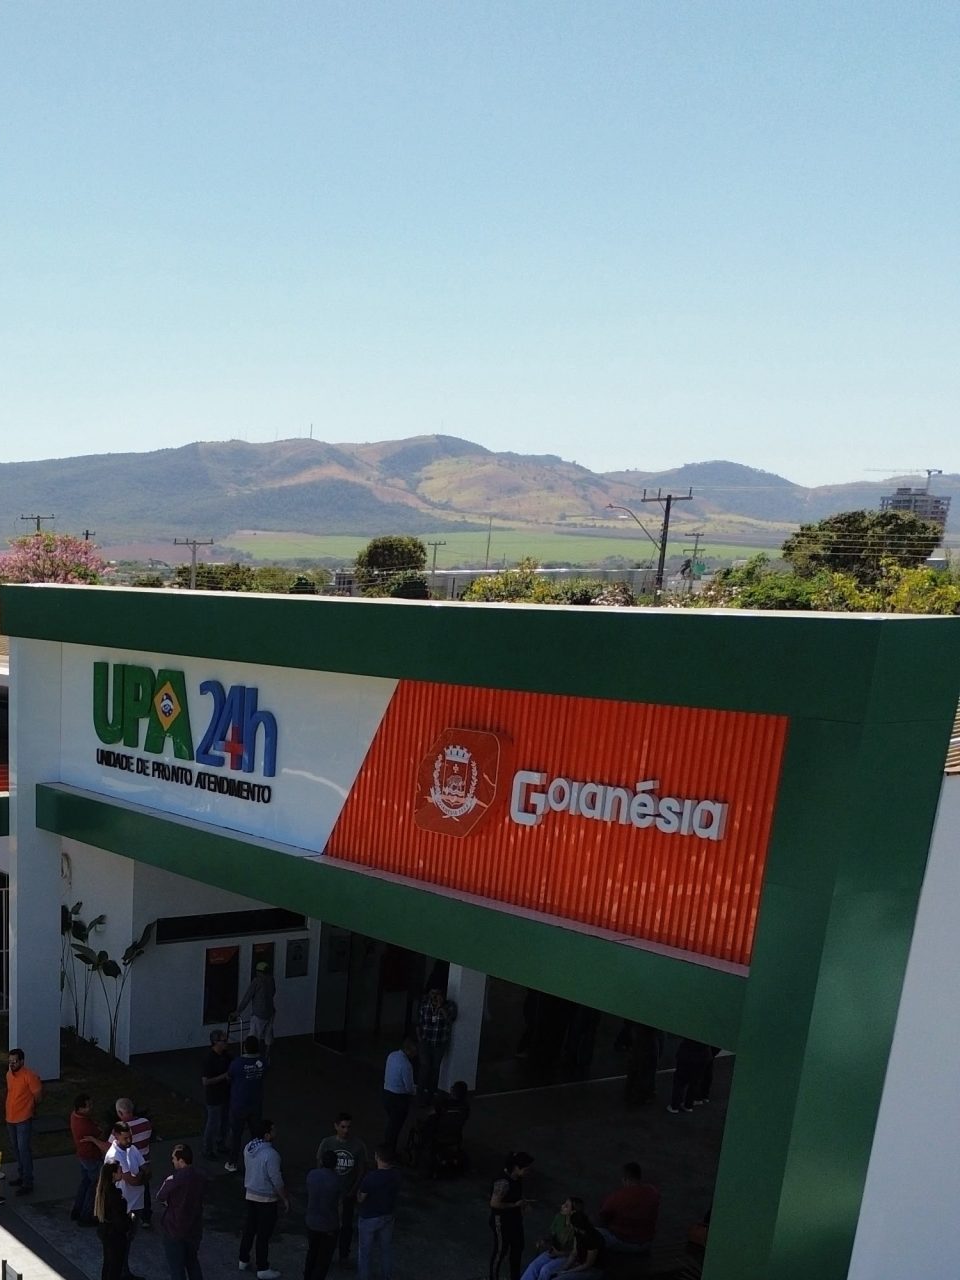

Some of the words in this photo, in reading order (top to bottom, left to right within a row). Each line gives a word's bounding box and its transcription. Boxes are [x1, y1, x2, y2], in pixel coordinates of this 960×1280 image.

[93, 662, 195, 761] UPA
[196, 680, 278, 778] 24h
[96, 748, 134, 773] UNIDADE
[135, 757, 151, 777] DE
[152, 761, 193, 786] PRONTO
[194, 771, 272, 804] ATENDIMENTO
[510, 769, 728, 841] Goianésia
